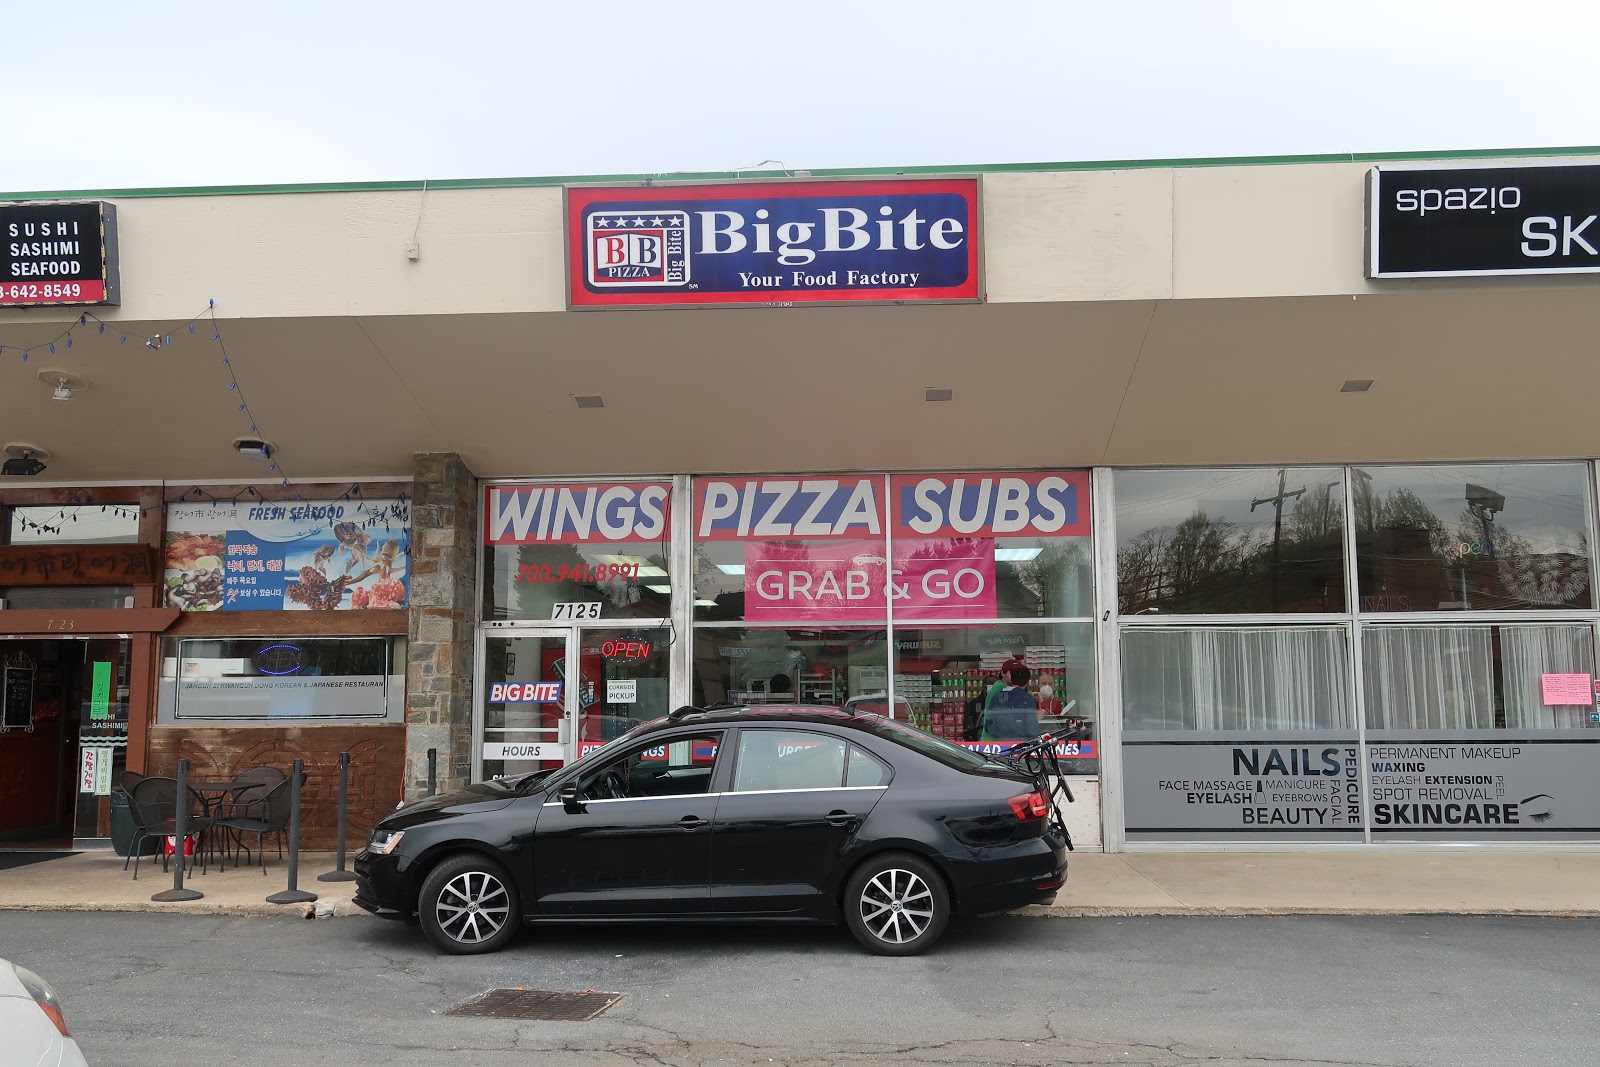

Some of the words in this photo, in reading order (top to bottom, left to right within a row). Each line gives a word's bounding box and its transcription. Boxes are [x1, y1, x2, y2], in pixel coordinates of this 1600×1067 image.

[1396, 186, 1521, 217] spazio
[9, 221, 79, 237] SUSHI
[1521, 214, 1599, 257] SK
[10, 241, 80, 257] SASHIMI
[668, 230, 683, 255] Bite
[11, 261, 81, 276] SEAFOOD
[608, 266, 651, 278] PIZZA
[668, 260, 685, 281] Big
[739, 272, 782, 289] Your
[792, 271, 838, 287] Food
[847, 270, 920, 288] Factory
[249, 507, 287, 520] FRESH
[289, 505, 345, 520] SEAFOOD
[489, 485, 668, 541] WINGS
[699, 479, 881, 537] PIZZA
[908, 476, 1070, 533] SUBS
[1447, 541, 1493, 559] open
[514, 563, 640, 584] 703.941.8991
[755, 570, 870, 601] GRAB
[883, 570, 911, 600] &
[921, 568, 985, 599] GO
[554, 603, 599, 619] 7125
[1364, 595, 1409, 611] NAILS
[602, 641, 651, 659] OPEN
[490, 684, 521, 701] BIG
[522, 683, 560, 701] BITE
[608, 692, 635, 700] PICKUP
[502, 746, 541, 757] HOURS
[1370, 747, 1456, 759] PERMANENT
[1461, 747, 1521, 759] MAKEUP
[1232, 748, 1341, 777] NAILS
[1371, 762, 1426, 773] WAXING
[1159, 780, 1189, 791] FACE
[1193, 780, 1253, 791] MASSAGE
[1265, 779, 1326, 790] MANICURE
[1344, 748, 1360, 824] PEDICURE
[1372, 775, 1421, 785] EYELASH
[1425, 775, 1493, 785] EXTENSION
[1495, 775, 1505, 800] PEEL
[1187, 792, 1252, 804] EYELASH
[1272, 793, 1328, 803] EYEBROWS
[1329, 779, 1342, 824] FACIAL
[1373, 788, 1413, 800] SPOT
[1418, 788, 1493, 800] REMOVAL
[1242, 807, 1328, 824] BEAUTY
[1374, 803, 1520, 825] SKINCARE
